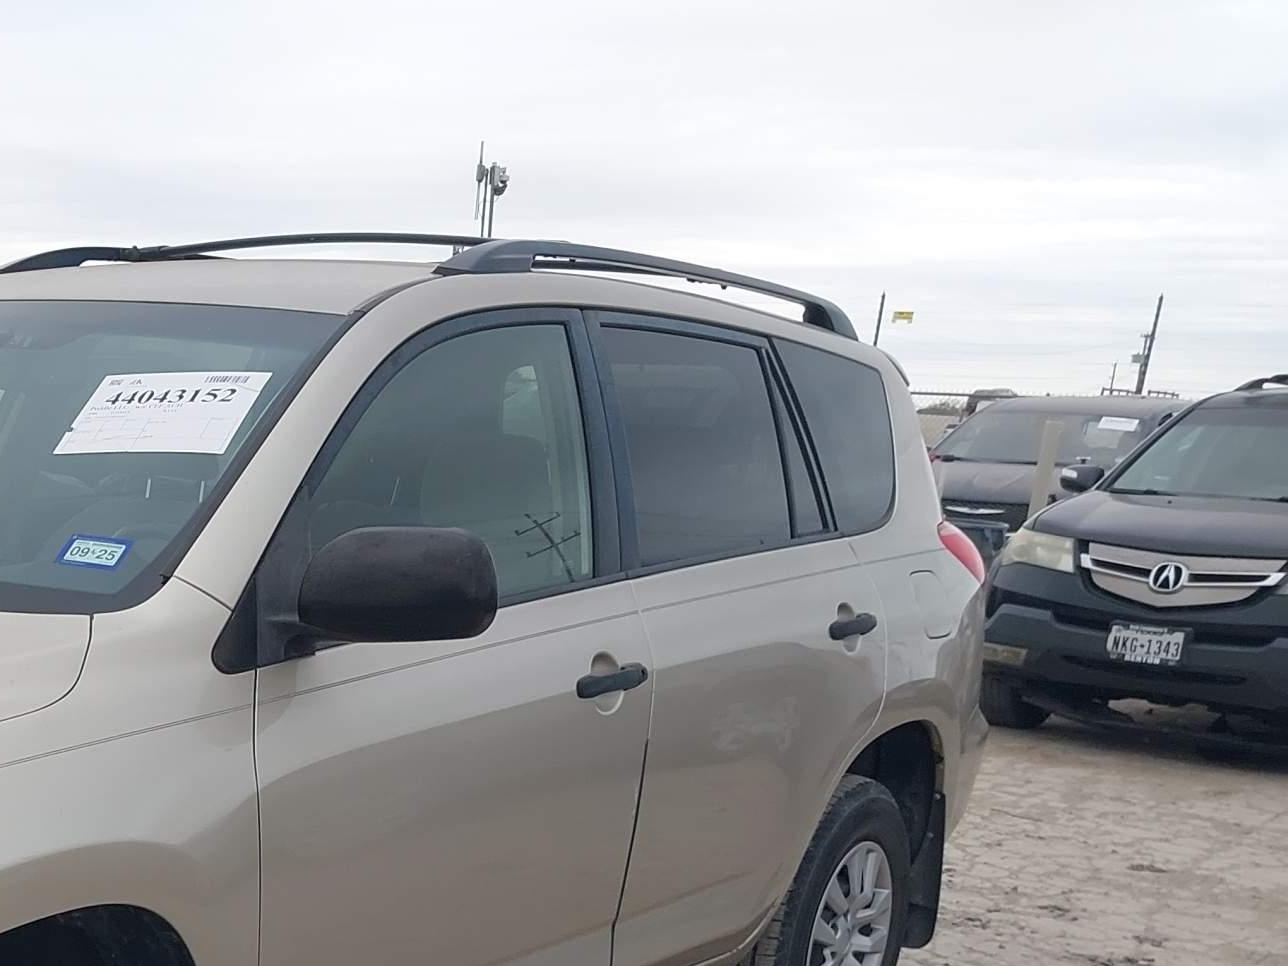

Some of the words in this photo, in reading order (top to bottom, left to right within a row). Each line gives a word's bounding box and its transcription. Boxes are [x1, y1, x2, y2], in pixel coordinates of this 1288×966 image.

[105, 387, 238, 406] 44043152
[69, 544, 89, 557] 09
[95, 548, 117, 562] 25
